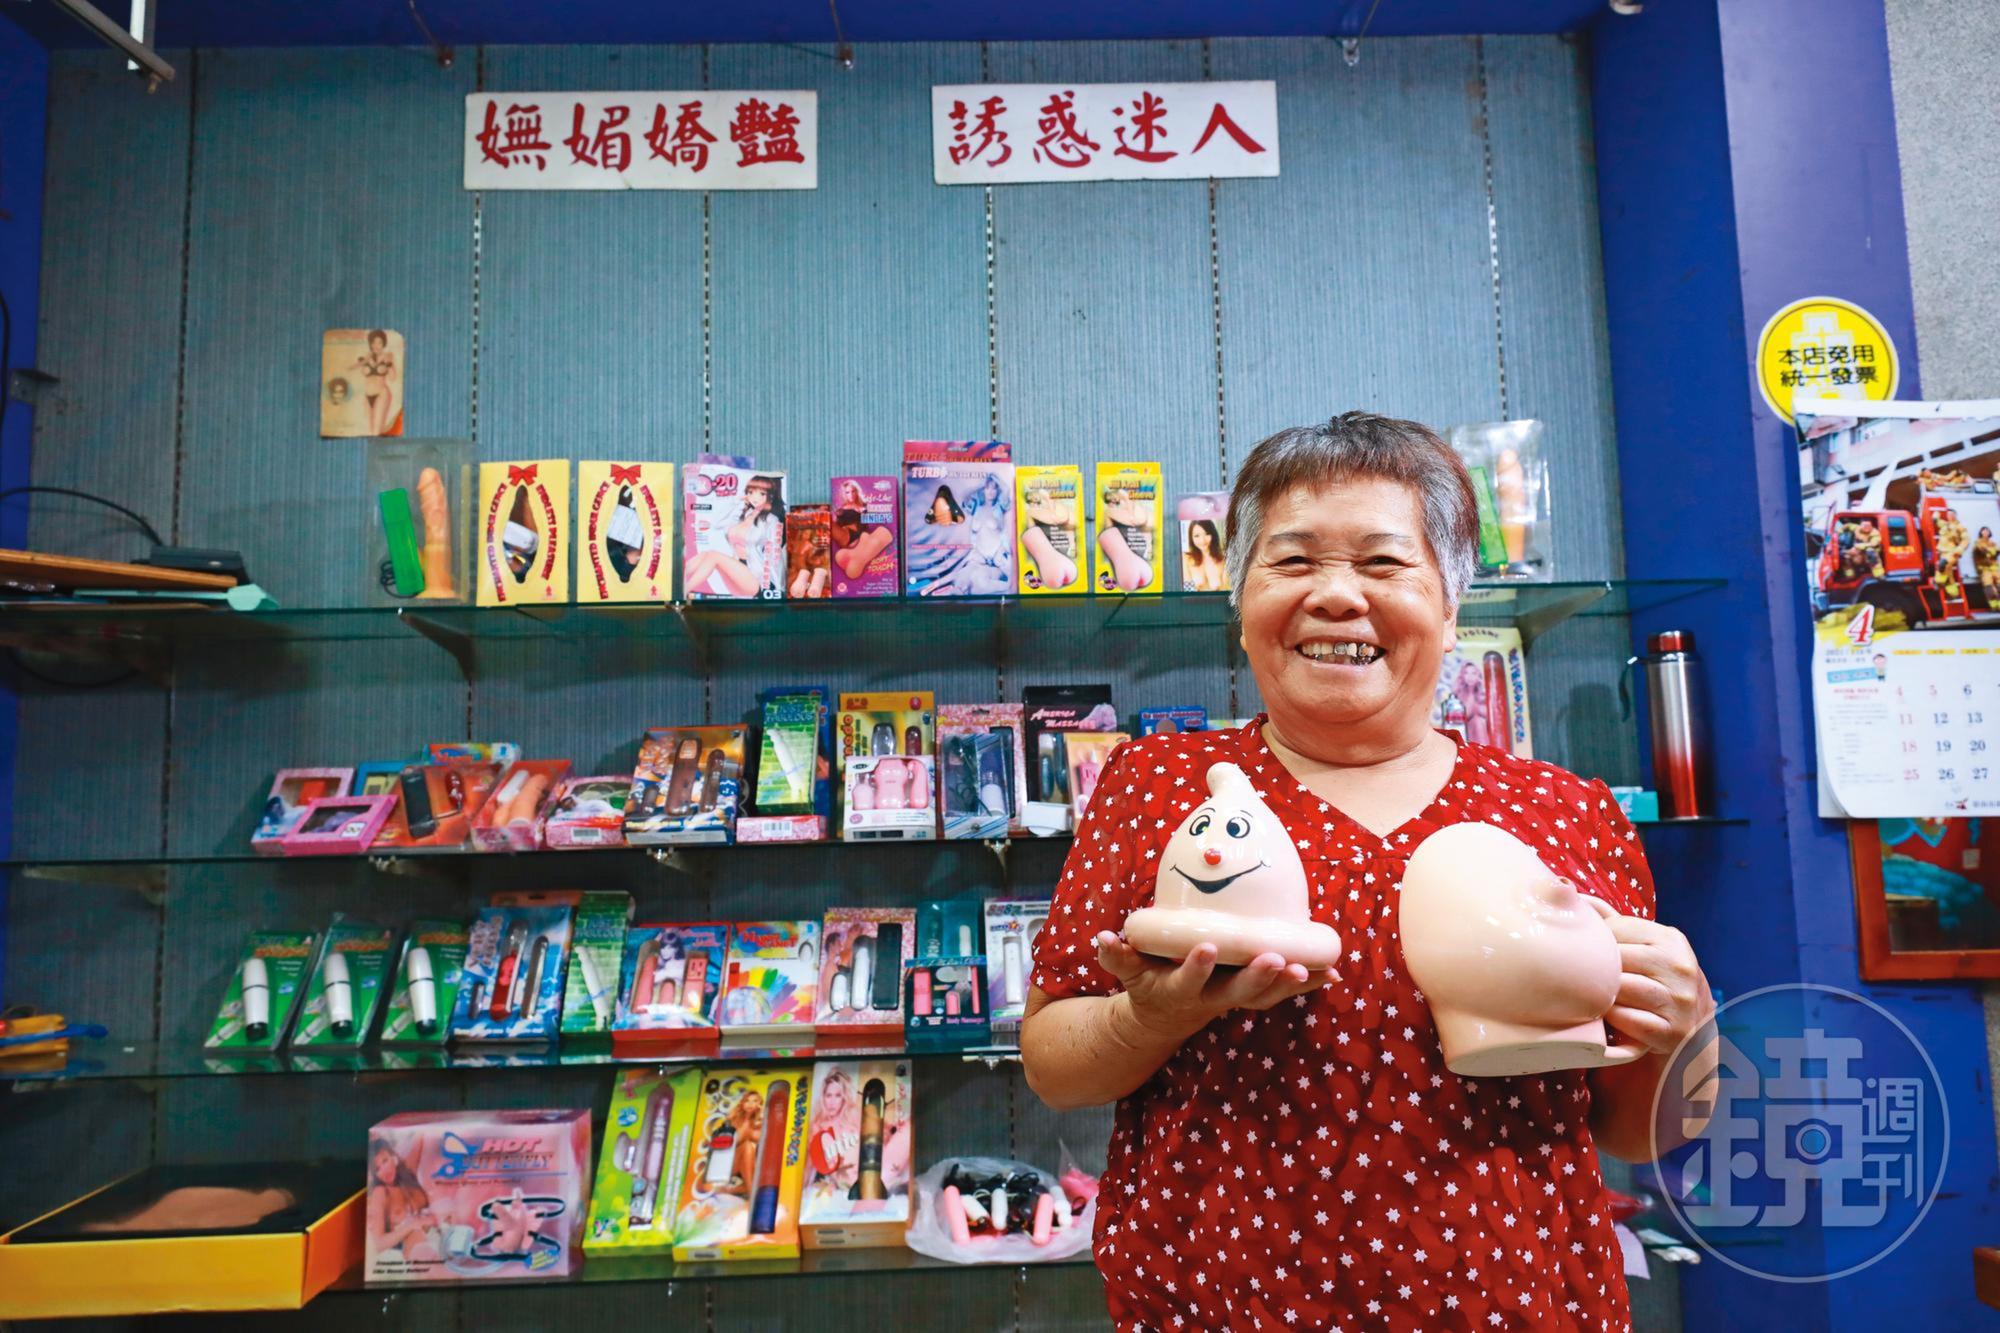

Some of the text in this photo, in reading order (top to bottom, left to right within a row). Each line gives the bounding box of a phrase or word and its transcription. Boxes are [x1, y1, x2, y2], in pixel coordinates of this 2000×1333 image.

[947, 90, 1267, 168] 誘惑迷人
[1777, 344, 1875, 366] 本店免用
[1780, 365, 1879, 387] 統一發票
[763, 589, 782, 600] 03
[1847, 606, 1873, 644] 4
[1963, 684, 1972, 695] 6
[1933, 712, 1949, 724] 12
[1967, 711, 1983, 723] 13
[1936, 740, 1951, 752] 19
[1970, 740, 1986, 751] 20
[1904, 768, 1988, 780] 25 26 27
[482, 1137, 542, 1153] HOT
